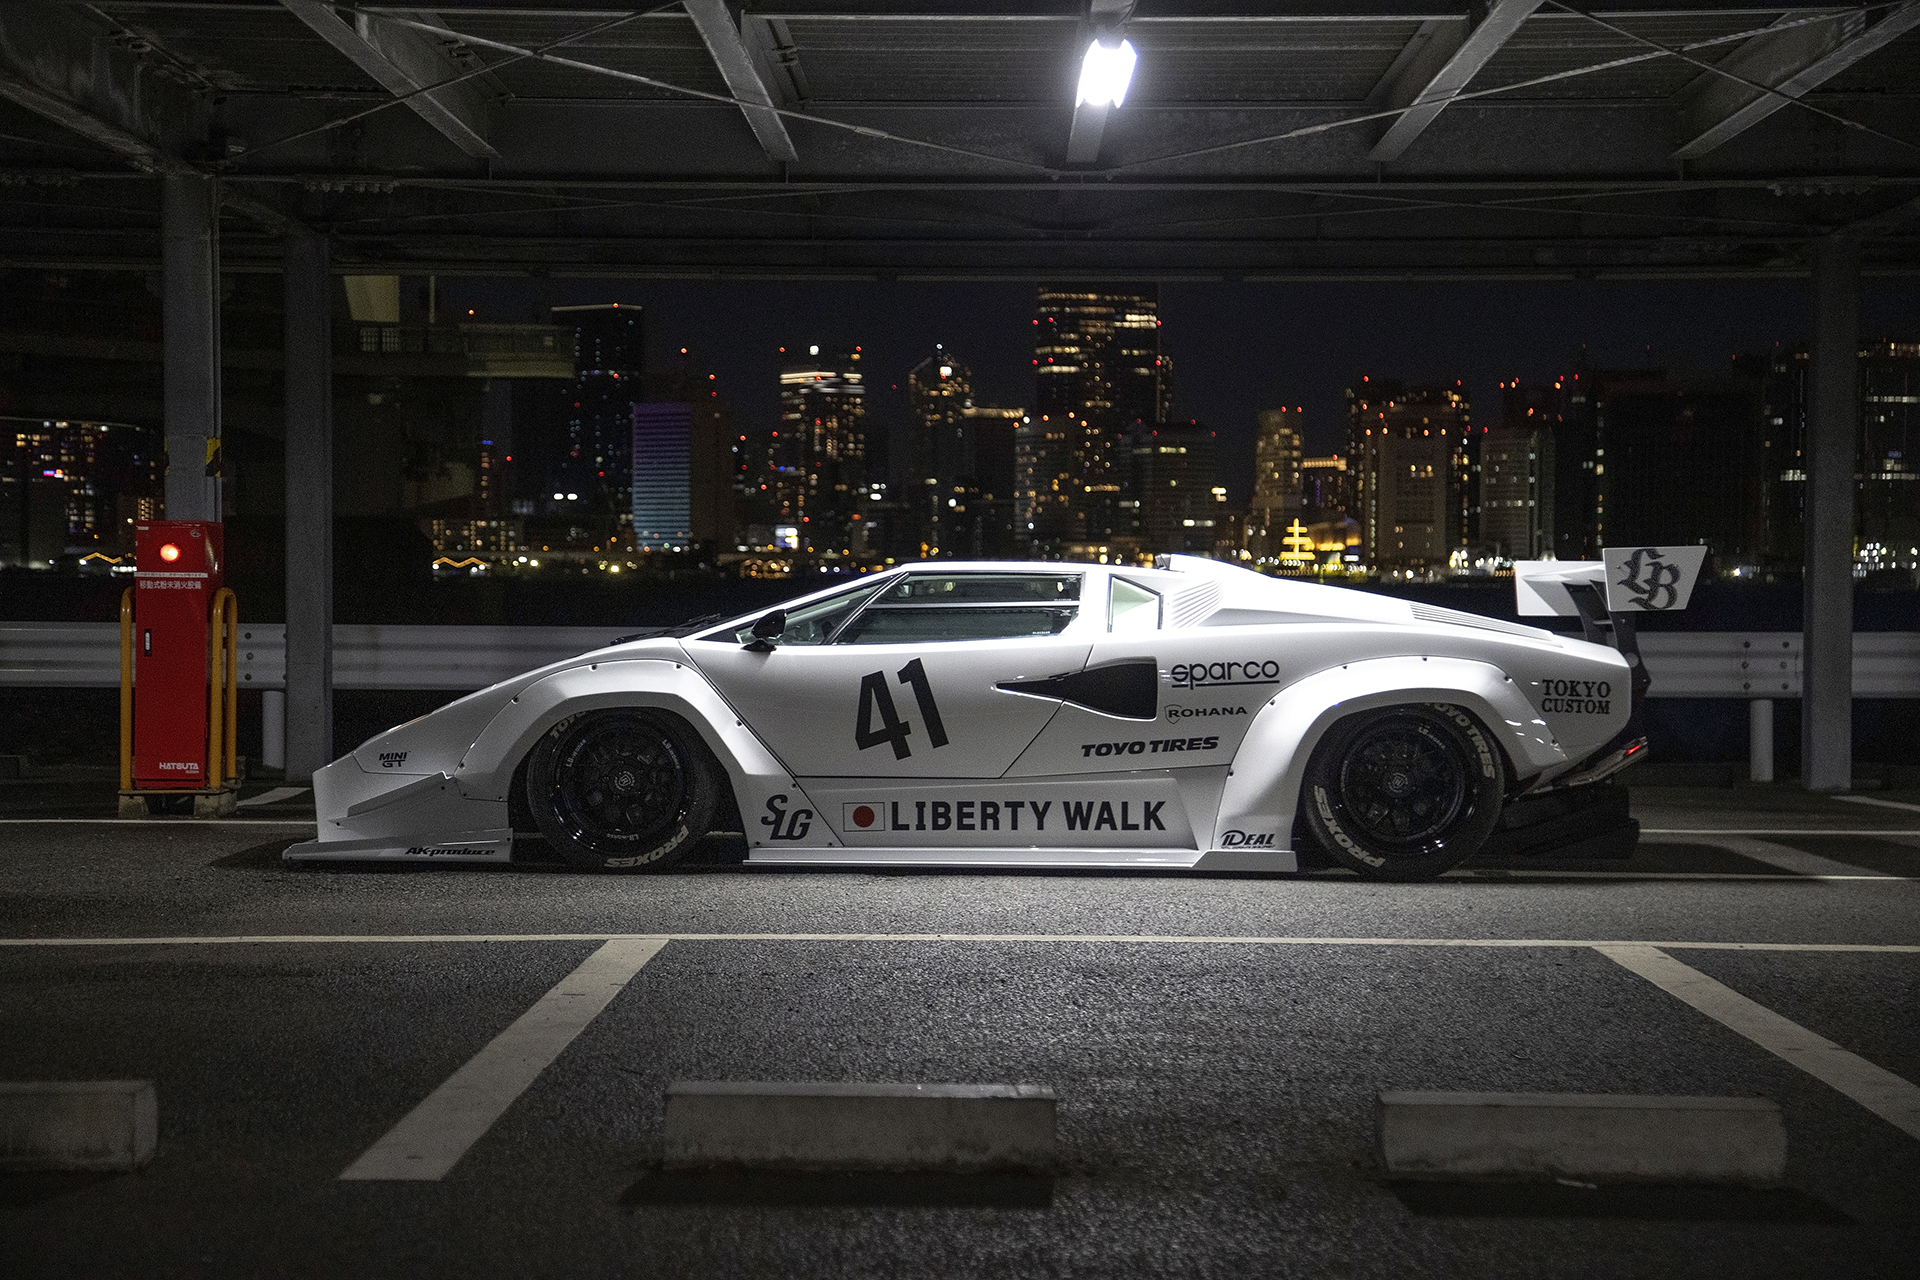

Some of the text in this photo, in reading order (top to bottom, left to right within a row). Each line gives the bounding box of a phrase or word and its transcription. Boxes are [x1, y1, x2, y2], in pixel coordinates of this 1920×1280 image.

[1171, 660, 1280, 690] sparco
[1542, 679, 1612, 699] TOKYO
[855, 657, 950, 761] 41
[1168, 706, 1248, 718] ROHANA
[1541, 698, 1611, 715] CUSTOM
[1081, 736, 1220, 758] TOYO TIRES
[1425, 703, 1496, 779] OYO TIRES
[159, 762, 199, 770] HATSUTA
[379, 752, 408, 761] MINI
[382, 760, 406, 768] GT
[891, 801, 1167, 831] LIBERTY WALK
[1314, 785, 1387, 868] PROXES
[604, 824, 690, 868] PROXES
[1220, 829, 1276, 846] IDEAL
[405, 847, 496, 857] AK-produce
